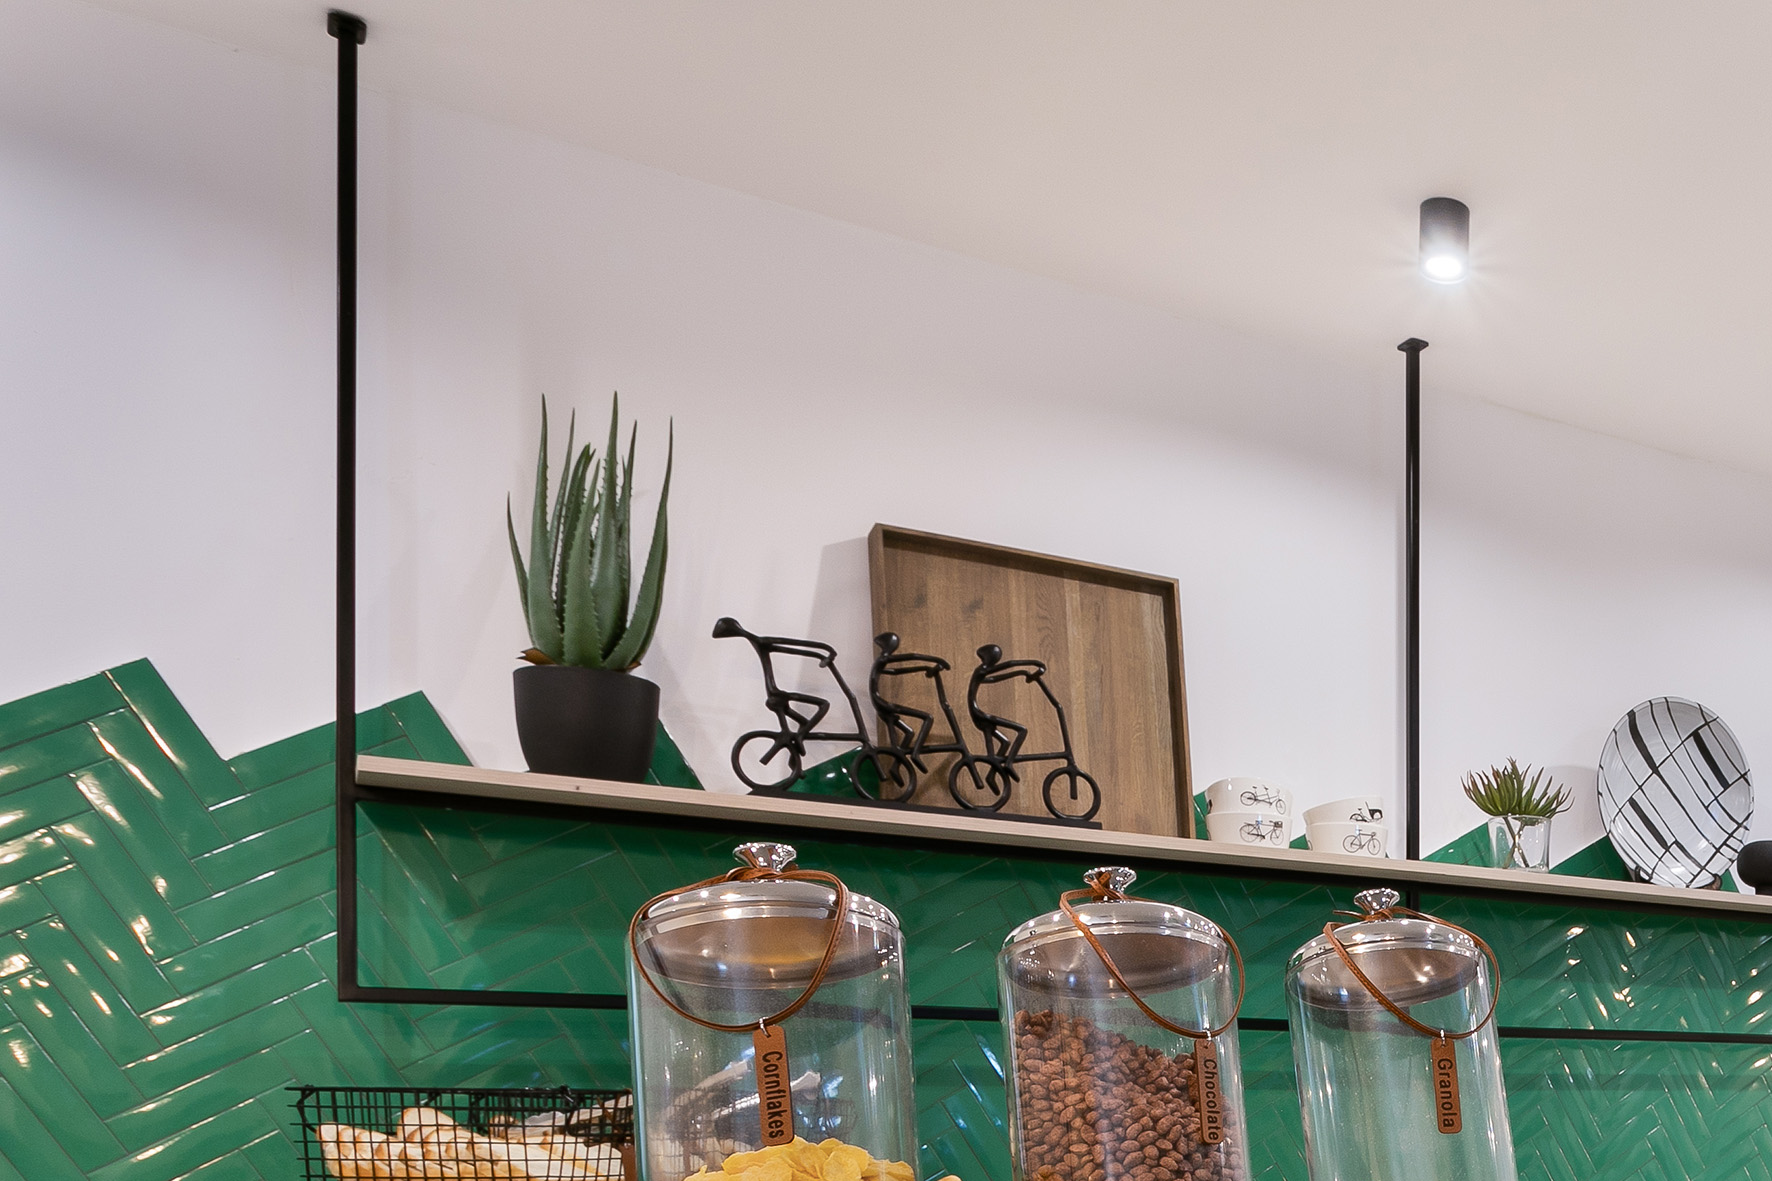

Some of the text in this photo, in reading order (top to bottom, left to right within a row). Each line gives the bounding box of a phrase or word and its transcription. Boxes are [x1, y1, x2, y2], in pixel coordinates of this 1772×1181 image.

[762, 1051, 788, 1139] Cornflakes
[1203, 1058, 1221, 1141] Chocolate
[1437, 1058, 1458, 1128] Granola
